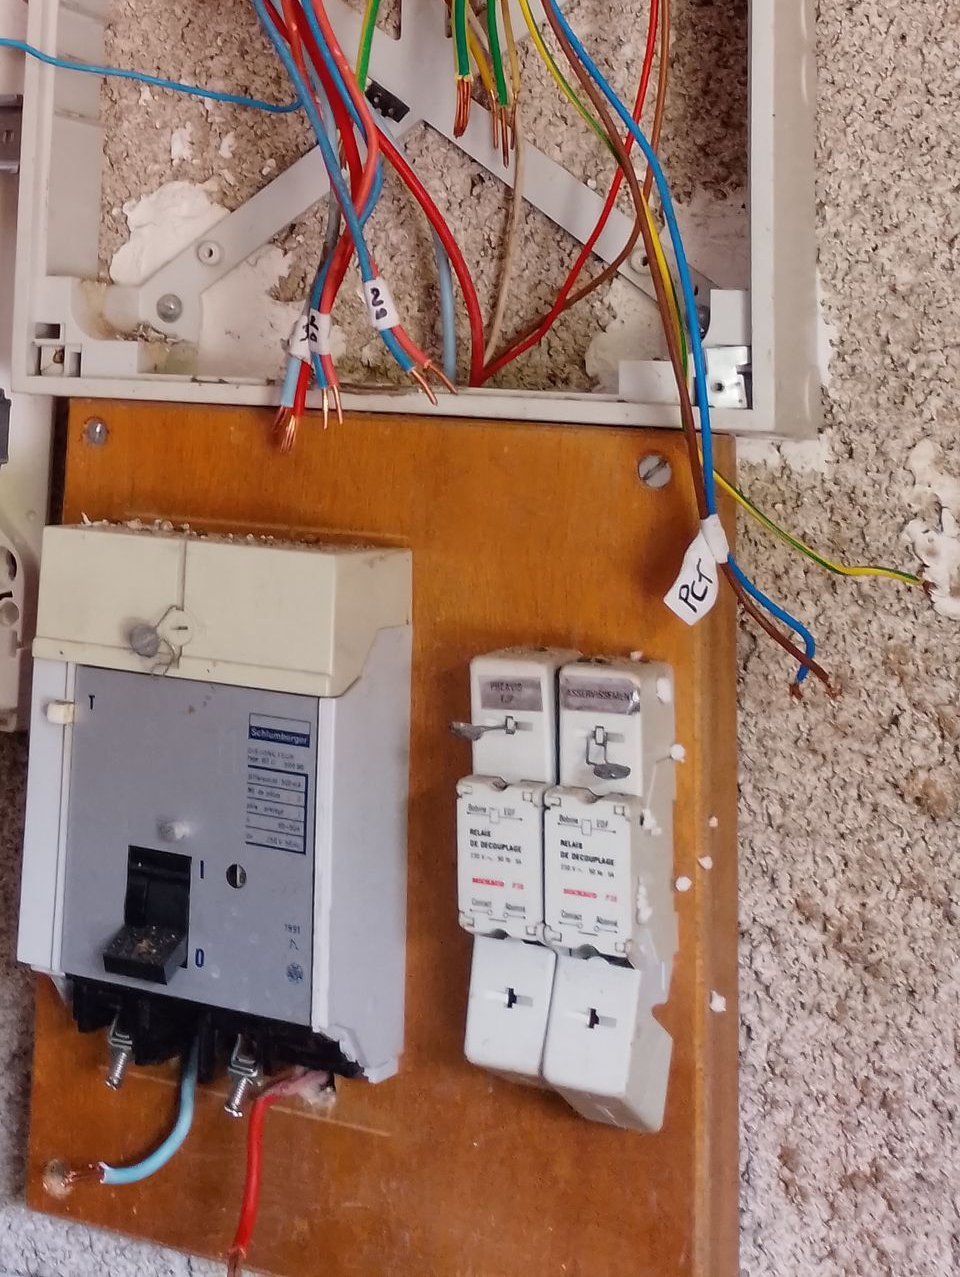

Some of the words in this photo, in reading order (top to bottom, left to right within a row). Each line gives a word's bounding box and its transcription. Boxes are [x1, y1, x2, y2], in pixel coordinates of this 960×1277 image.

[88, 694, 96, 710] T
[250, 726, 308, 745] Schlumberger
[480, 840, 522, 853] DECOUPLAGE
[571, 852, 614, 866] DECOUPLAGE
